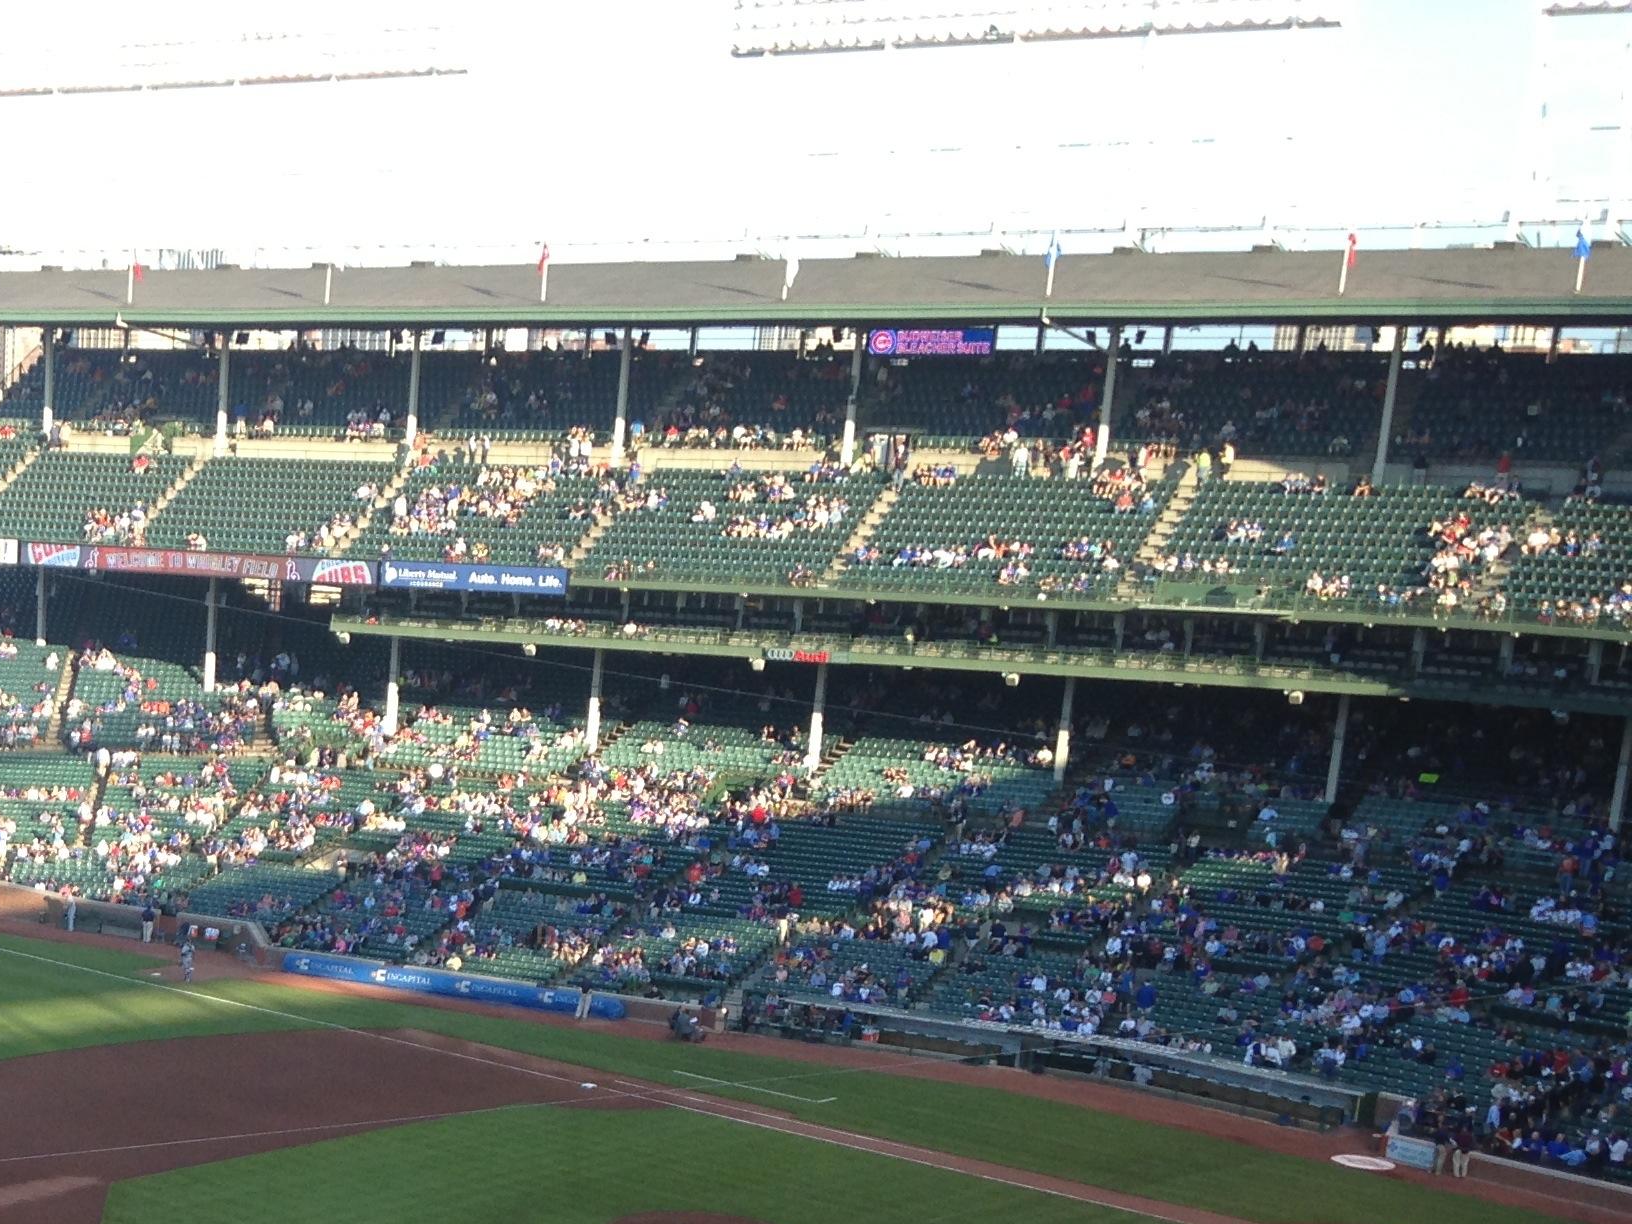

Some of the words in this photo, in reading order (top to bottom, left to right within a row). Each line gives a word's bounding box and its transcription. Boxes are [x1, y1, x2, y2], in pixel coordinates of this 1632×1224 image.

[896, 342, 956, 354] BLEACHER
[957, 341, 991, 354] SUITE
[106, 551, 165, 569] WELCOME
[167, 552, 183, 568] TO
[187, 555, 240, 573] WRIGLEY
[242, 558, 279, 578] FIELD
[399, 568, 426, 580] Liberty
[468, 571, 497, 585] Auto.
[500, 572, 535, 587] Home.
[539, 575, 563, 588] Life.
[795, 650, 829, 663] Audi
[386, 972, 432, 986] INCAPITAL
